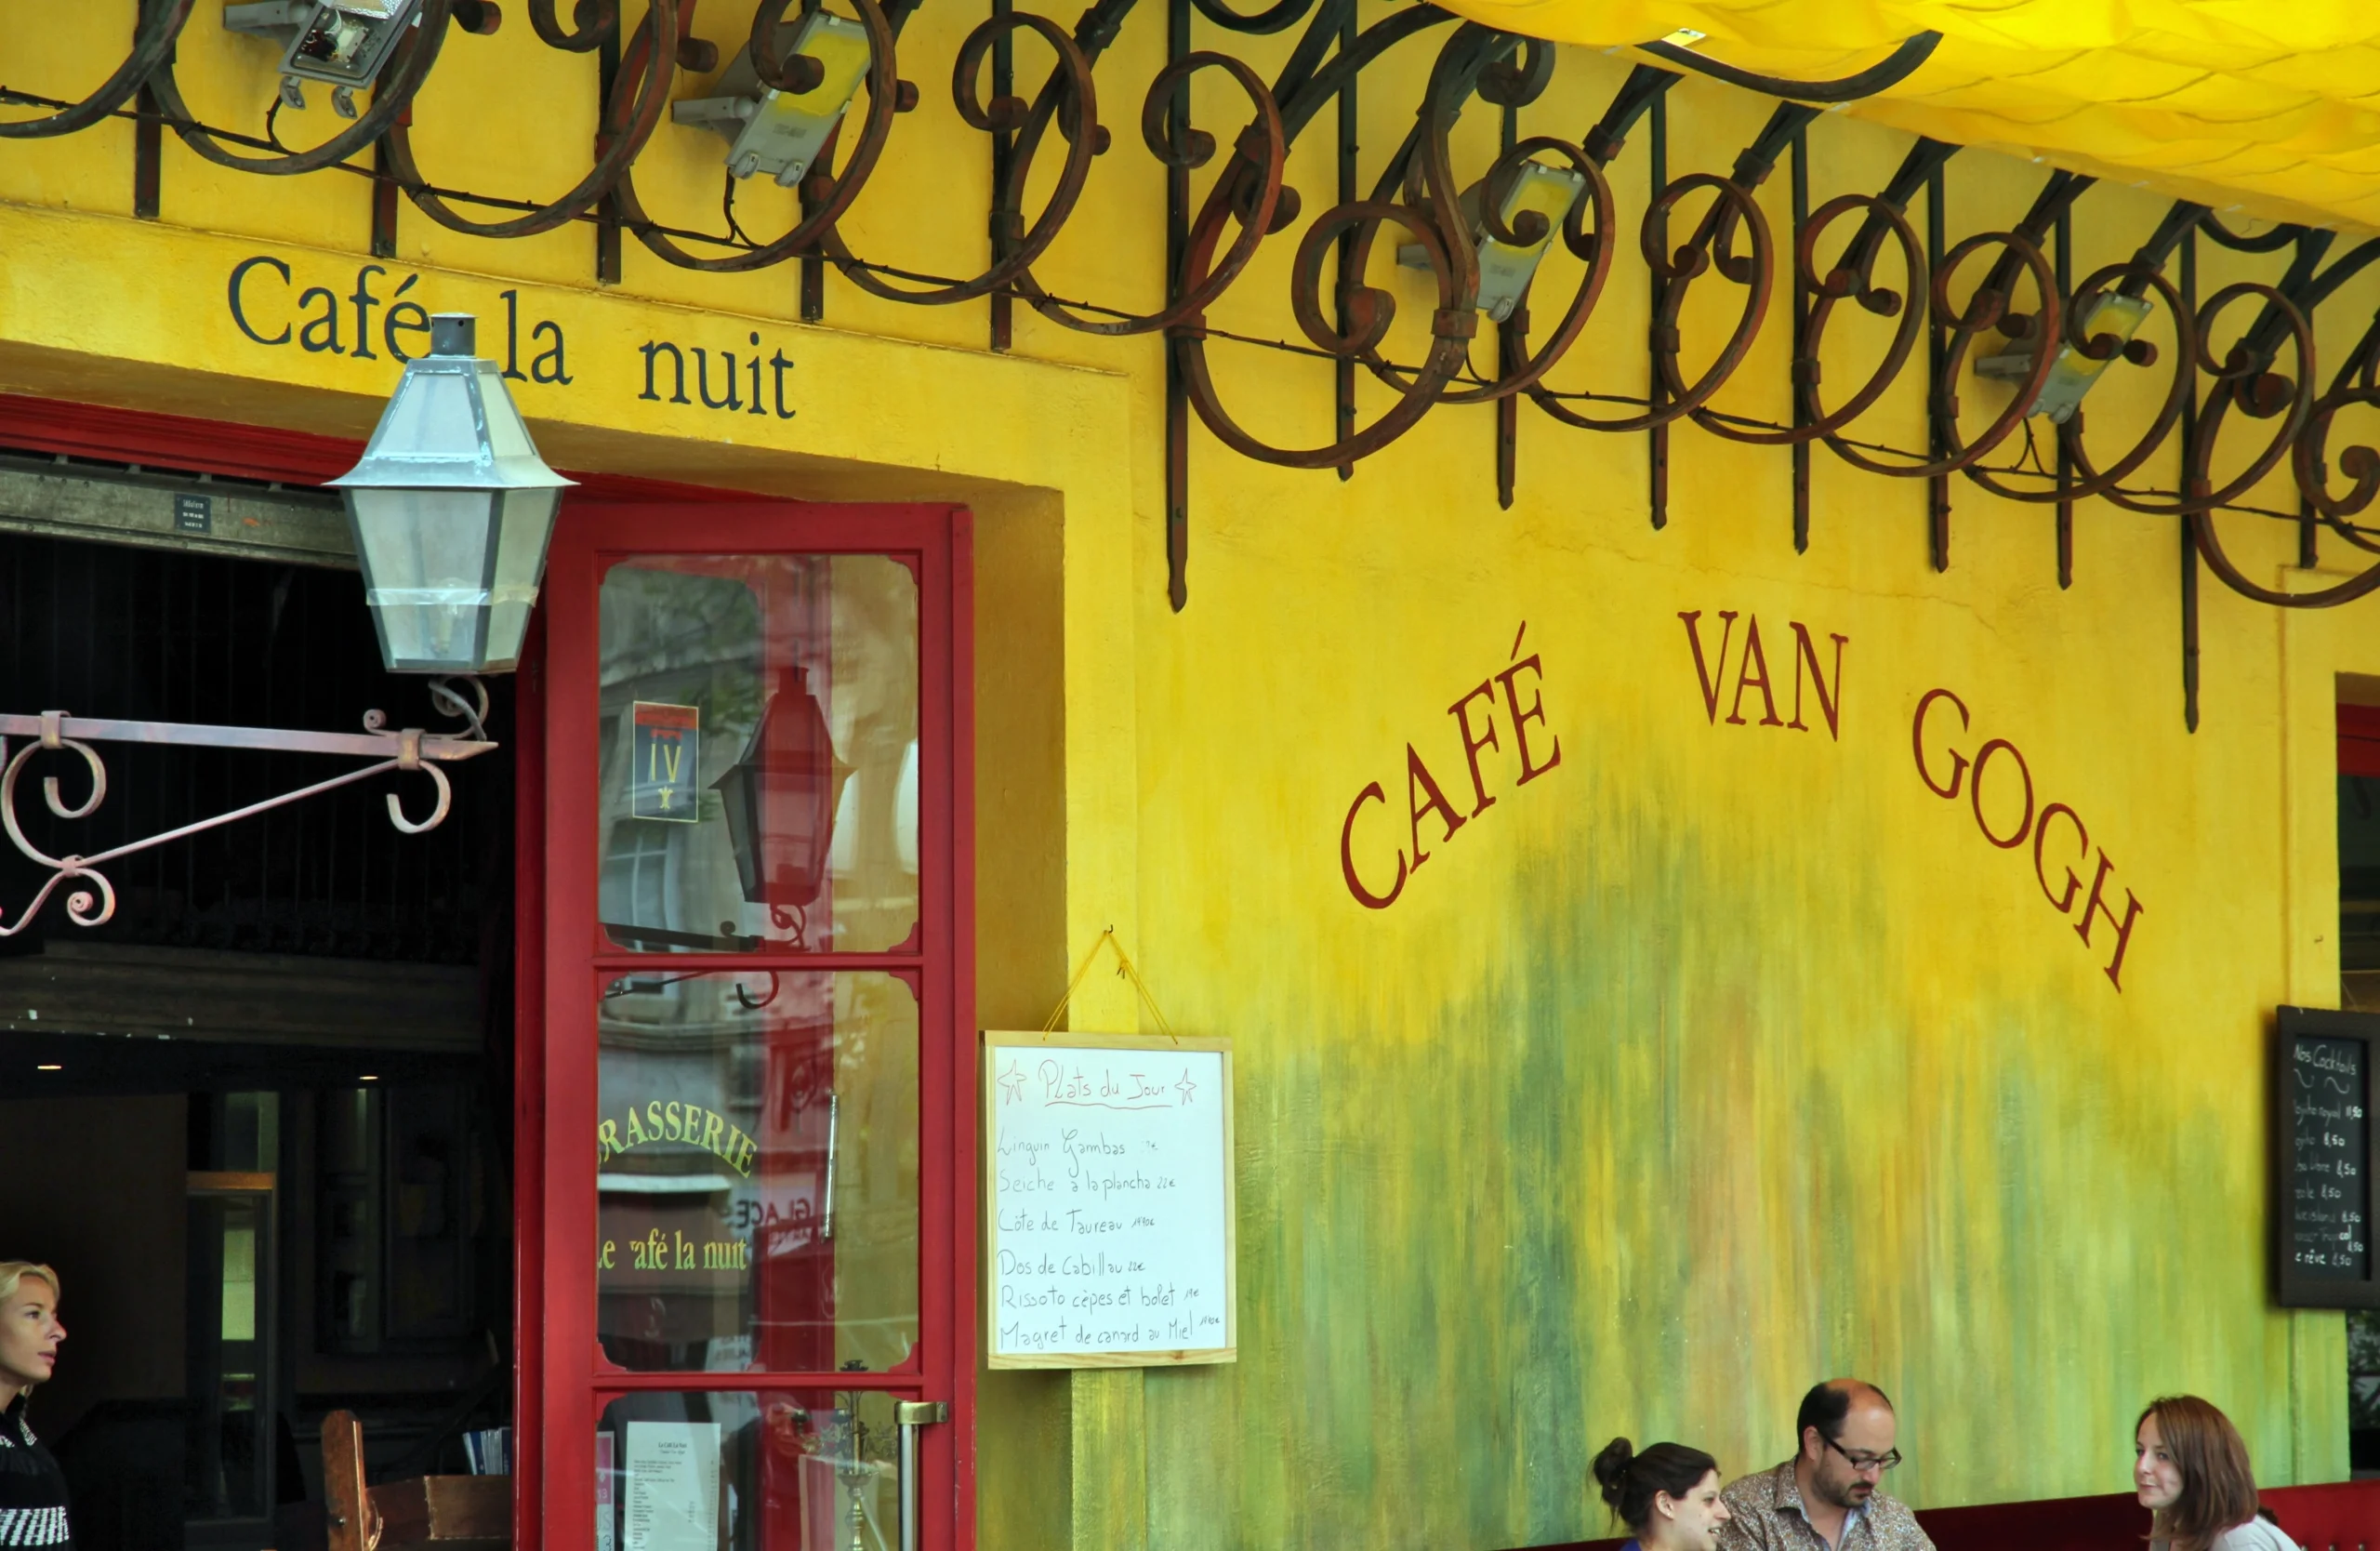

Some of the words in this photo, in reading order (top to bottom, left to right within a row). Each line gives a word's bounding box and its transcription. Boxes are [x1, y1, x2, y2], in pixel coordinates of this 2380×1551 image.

[228, 256, 431, 365] Café
[499, 289, 574, 385] la
[638, 331, 797, 419] nuit
[1341, 620, 1562, 909] CAFÉ
[1677, 609, 1849, 743] VAN
[1912, 688, 2145, 994] GOGH
[1038, 1059, 1091, 1099] Plats
[1101, 1068, 1119, 1098] du
[1127, 1074, 1166, 1100] Jour
[2293, 1042, 2312, 1063] Nos
[2312, 1044, 2357, 1076] Cocktails
[2293, 1094, 2317, 1125] ojito
[599, 1100, 758, 1178] RASSERIE
[1062, 1128, 1126, 1178] Gambas
[999, 1167, 1055, 1192] Seiche
[1086, 1170, 1098, 1191] la
[1103, 1170, 1151, 1200] plancha
[1041, 1210, 1059, 1231] de
[1065, 1209, 1123, 1235] Taureau
[599, 1239, 616, 1269] e
[629, 1227, 668, 1270] afé
[675, 1230, 696, 1270] la
[704, 1238, 747, 1270] nuit
[997, 1249, 1032, 1277] Dos
[1038, 1253, 1056, 1274] de
[1001, 1285, 1065, 1309] Rissoto
[1072, 1290, 1114, 1315] cèpes
[1118, 1285, 1131, 1306] et
[1141, 1281, 1176, 1307] bolet
[1000, 1316, 1067, 1350] Magret
[1076, 1323, 1091, 1346] de
[1098, 1323, 1140, 1345] canard
[1148, 1329, 1161, 1341] au
[1169, 1309, 1193, 1341] Miel
